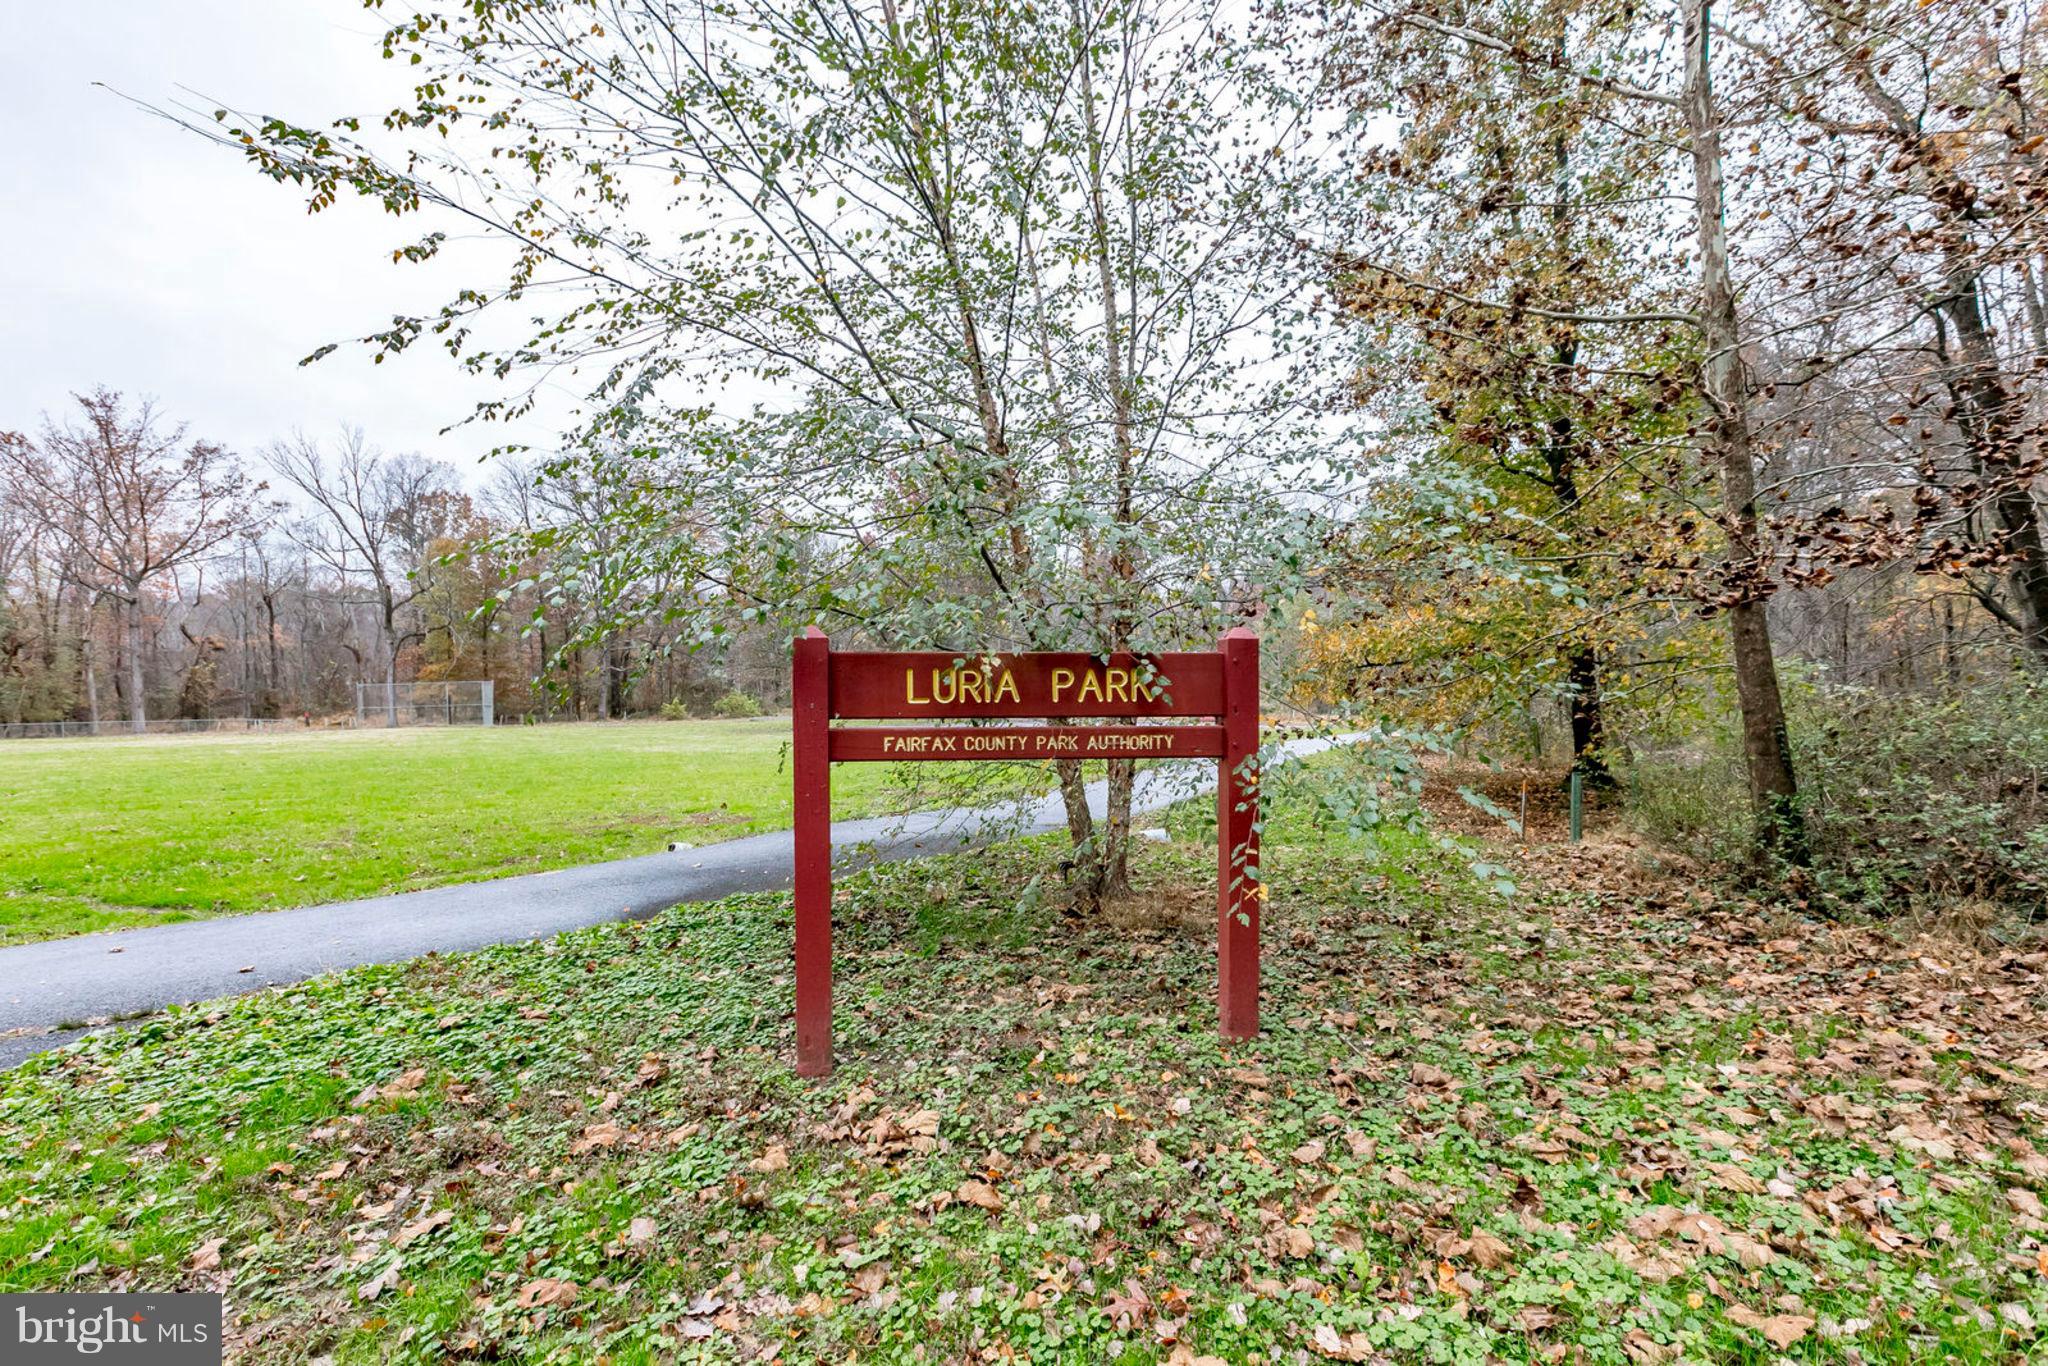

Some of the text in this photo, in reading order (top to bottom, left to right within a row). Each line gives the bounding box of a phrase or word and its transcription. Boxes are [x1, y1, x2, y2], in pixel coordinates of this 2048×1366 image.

[906, 667, 1154, 704] LURIA PARK
[883, 734, 1174, 753] FAIRFAX COUNTY PARK AUTHORITY
